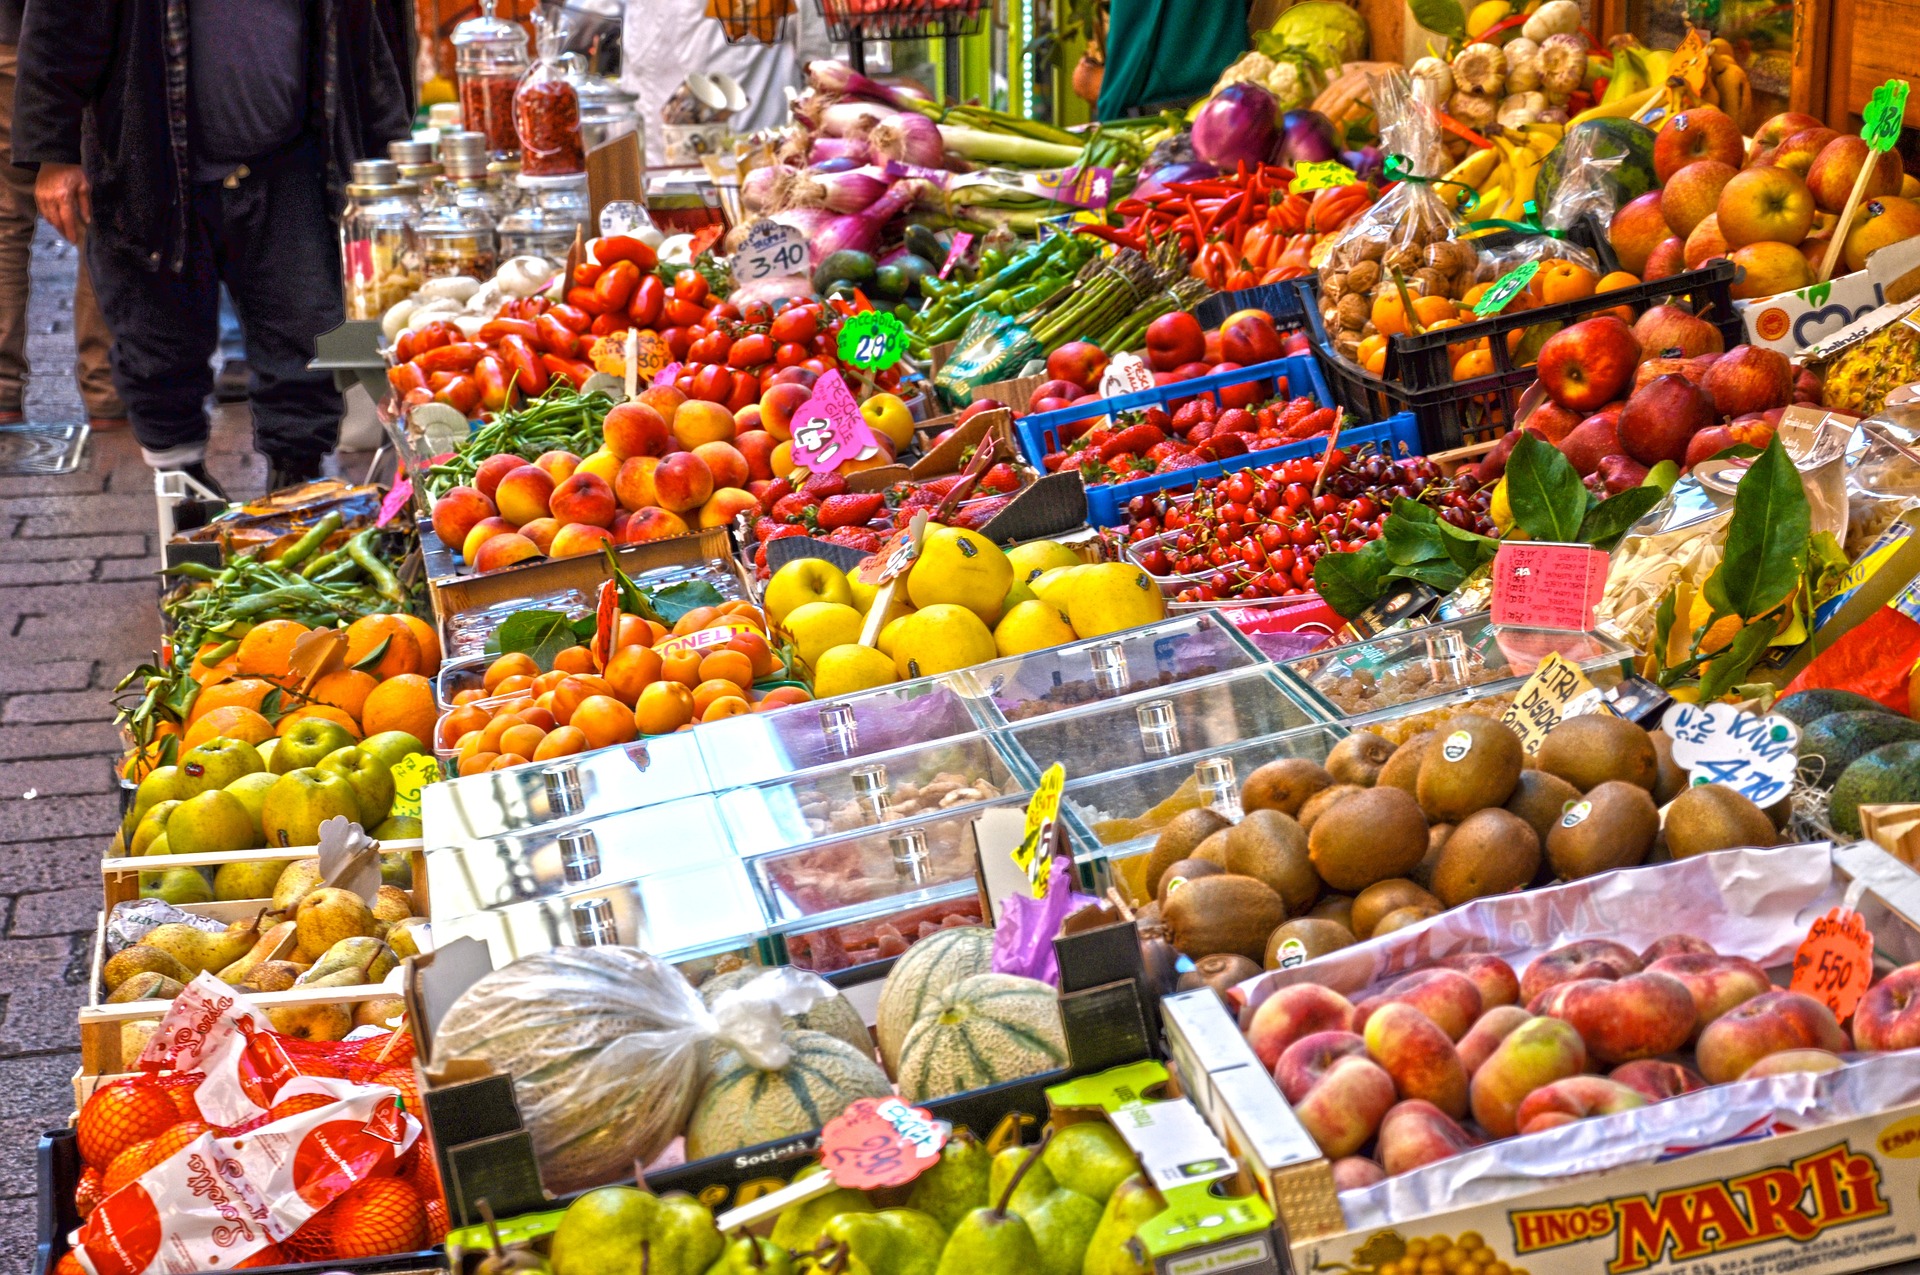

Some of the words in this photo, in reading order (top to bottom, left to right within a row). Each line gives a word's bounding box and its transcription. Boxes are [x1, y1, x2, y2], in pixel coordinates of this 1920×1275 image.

[750, 243, 803, 279] 3.40
[1537, 658, 1580, 703] ALTRA
[735, 1141, 807, 1169] Società
[1513, 1207, 1612, 1251] HNOS
